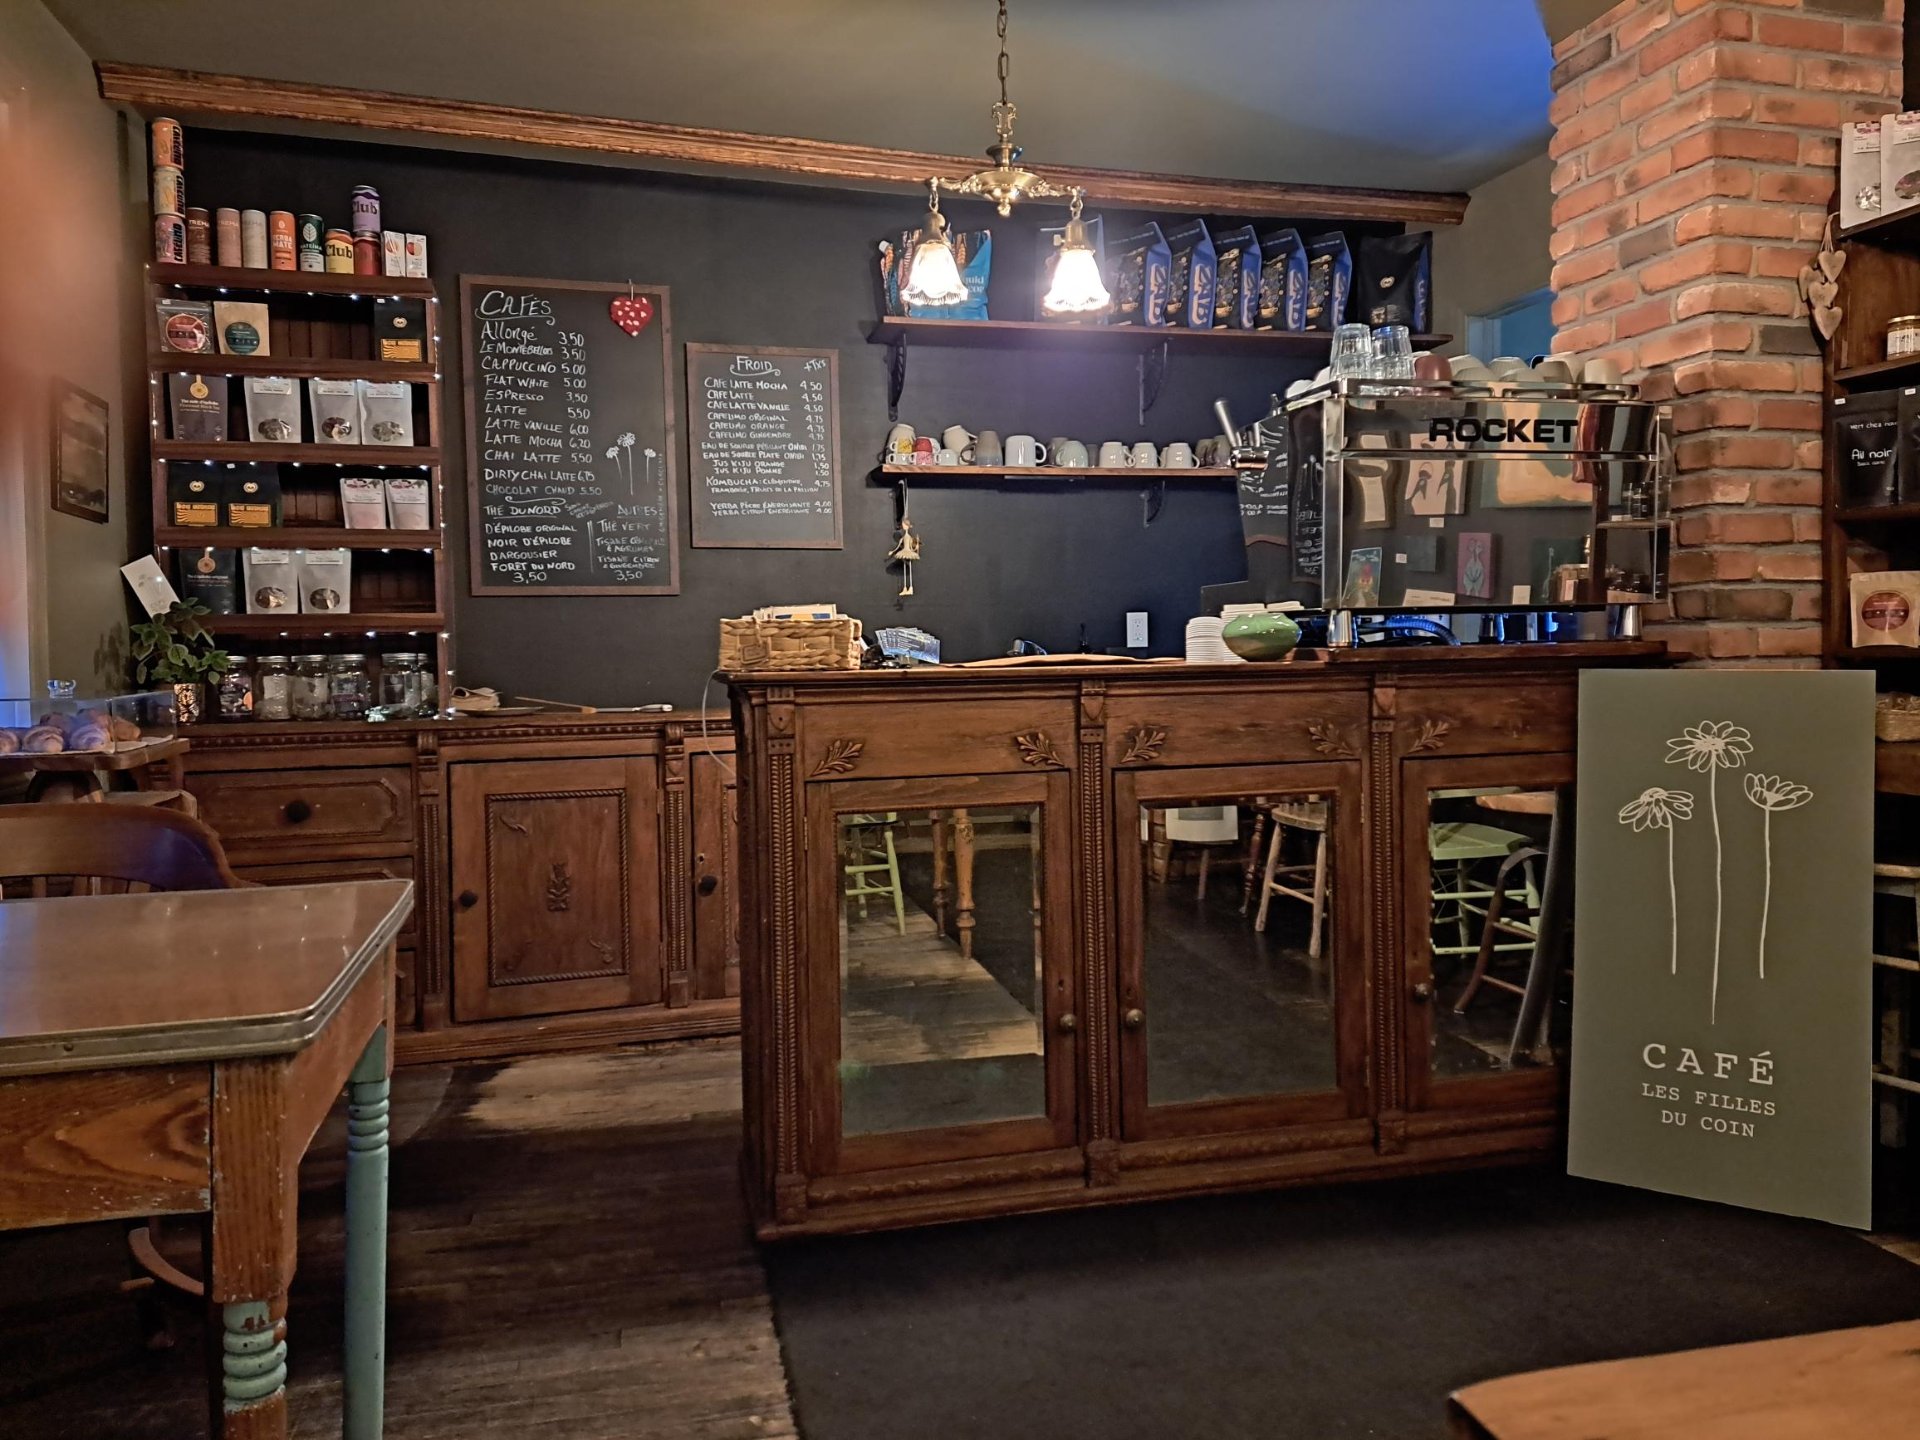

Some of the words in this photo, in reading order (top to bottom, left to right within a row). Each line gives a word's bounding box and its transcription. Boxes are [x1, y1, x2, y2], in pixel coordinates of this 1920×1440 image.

[326, 244, 353, 259] Club
[481, 356, 557, 374] CAPPUCCINO
[736, 356, 773, 371] FROID
[484, 373, 515, 387] FLAT
[517, 378, 550, 389] WHITE
[730, 380, 753, 390] LATTE
[756, 380, 788, 391] MOCHA
[484, 389, 544, 401] ESPRESSO
[730, 390, 754, 401] LATTE
[485, 403, 528, 416] LATTE
[729, 401, 756, 410] LATTE
[484, 416, 521, 430] LATTE
[524, 420, 564, 434] VANILLE
[750, 423, 785, 431] ORANGE
[1429, 418, 1579, 443] ROCKET
[484, 430, 522, 445] LATTE
[528, 435, 563, 449] MOCHA
[701, 442, 717, 450] EAU
[484, 449, 515, 461] CHAI
[523, 451, 562, 463] LATTE
[703, 452, 719, 460] EAU
[712, 460, 728, 468] JUS
[484, 468, 520, 482] DIRTY
[520, 470, 547, 481] CHAI
[550, 470, 576, 482] LATTE
[486, 484, 539, 495] CHOCOLAT
[545, 485, 575, 495] CHAUD
[527, 505, 561, 516] NORD
[487, 538, 518, 548] NOIR
[530, 562, 544, 570] DU
[547, 561, 576, 571] NORD
[1643, 1043, 1774, 1085] CAFÉ
[1642, 1083, 1680, 1101] LES
[1695, 1091, 1776, 1116] FILLES
[1661, 1110, 1687, 1126] DU
[1701, 1117, 1755, 1137] COIN
